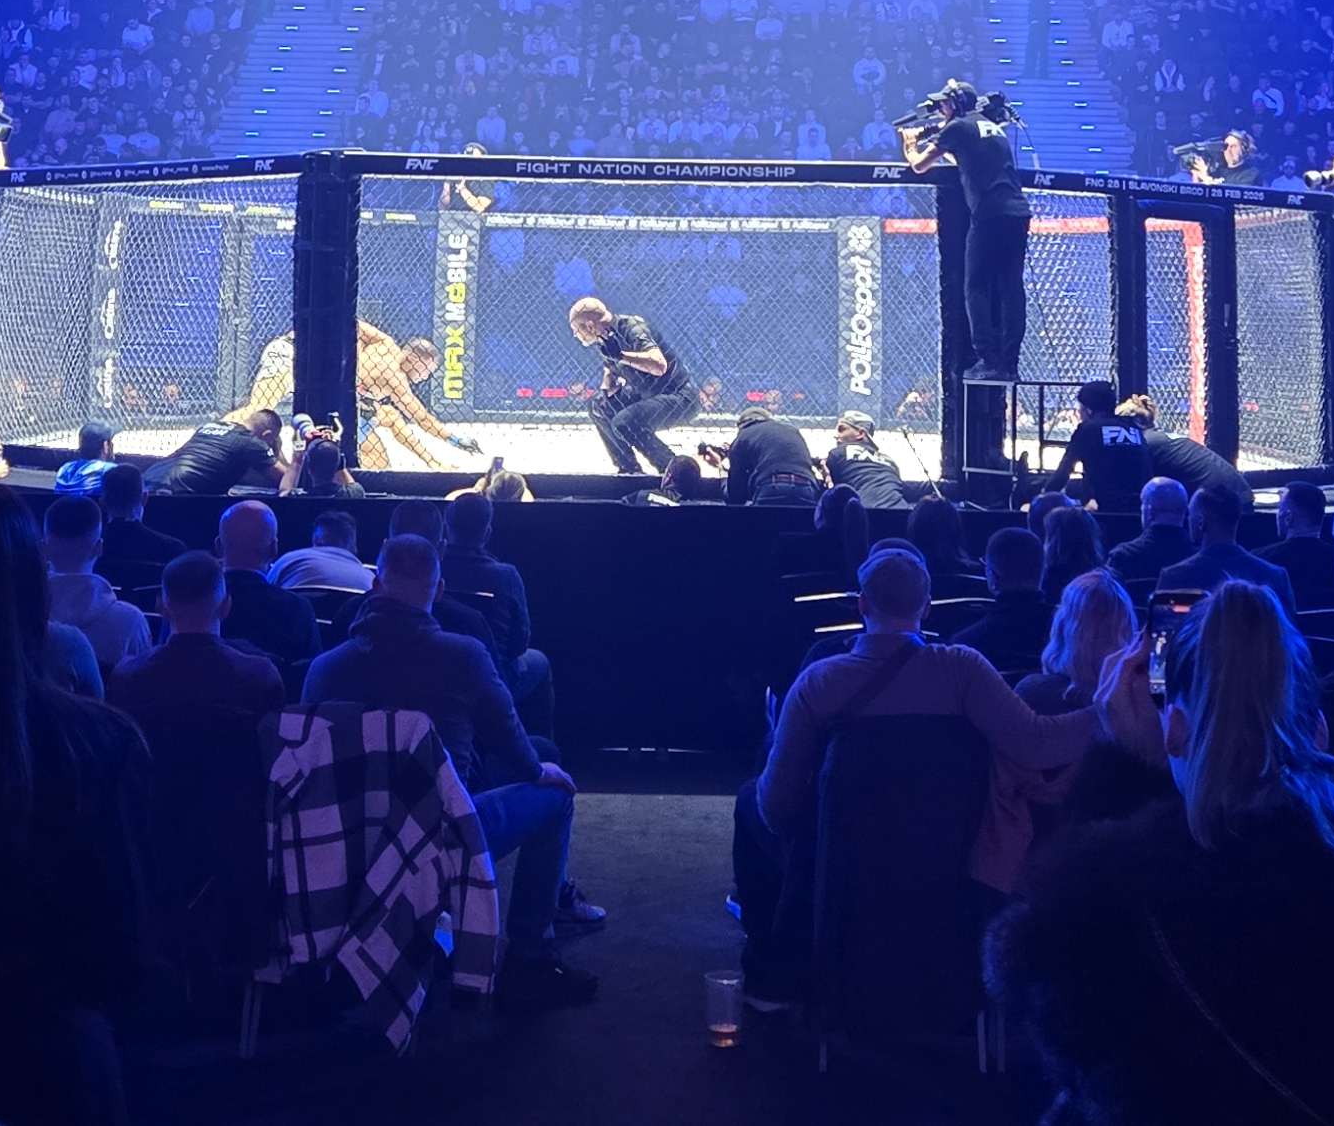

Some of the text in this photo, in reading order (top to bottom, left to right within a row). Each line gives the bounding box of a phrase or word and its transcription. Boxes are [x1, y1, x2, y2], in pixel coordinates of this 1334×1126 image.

[254, 159, 275, 171] FNC
[406, 159, 440, 171] FNC
[516, 162, 796, 178] FIGHT NATION CHAMPIONSHIP
[873, 166, 905, 179] FNC
[1085, 178, 1105, 188] FNC
[1128, 180, 1178, 195] SLAVONSKI
[1179, 185, 1204, 197] BROD
